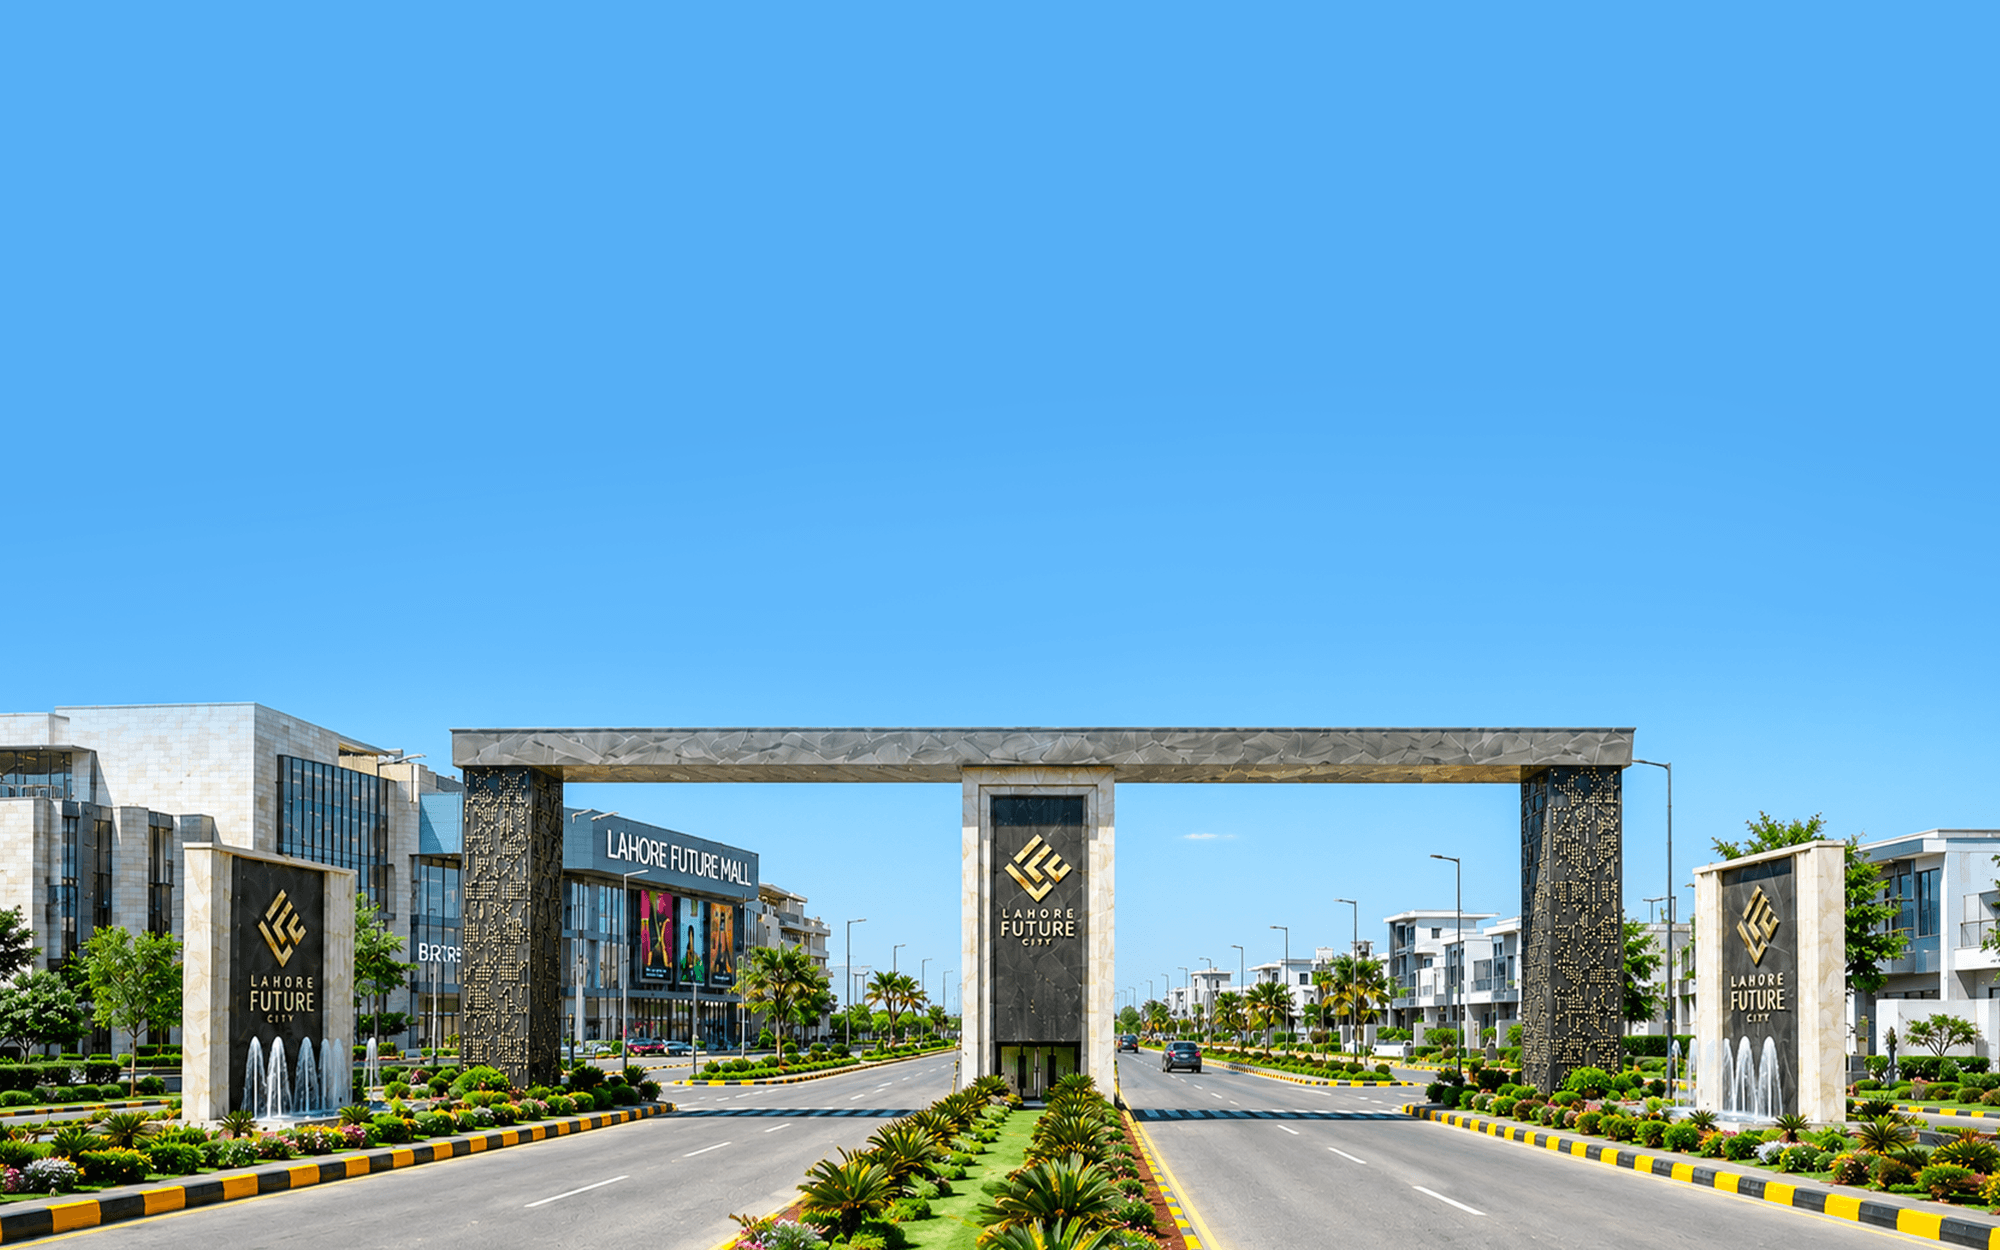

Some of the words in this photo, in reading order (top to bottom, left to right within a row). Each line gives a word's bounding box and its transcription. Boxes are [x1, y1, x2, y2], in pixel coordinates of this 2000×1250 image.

[607, 829, 668, 869] LAHORE
[671, 844, 719, 880] FUTURE
[720, 856, 752, 887] MALL
[1002, 908, 1074, 919] LAHORE
[1001, 921, 1075, 937] FUTURE
[1021, 938, 1052, 946] CITY
[250, 974, 314, 989] LAHORE
[1730, 971, 1784, 988] LAHORE
[250, 990, 315, 1012] FUTURE
[1730, 988, 1786, 1011] FUTURE
[267, 1014, 295, 1023] CITY
[1746, 1013, 1770, 1023] CITY
